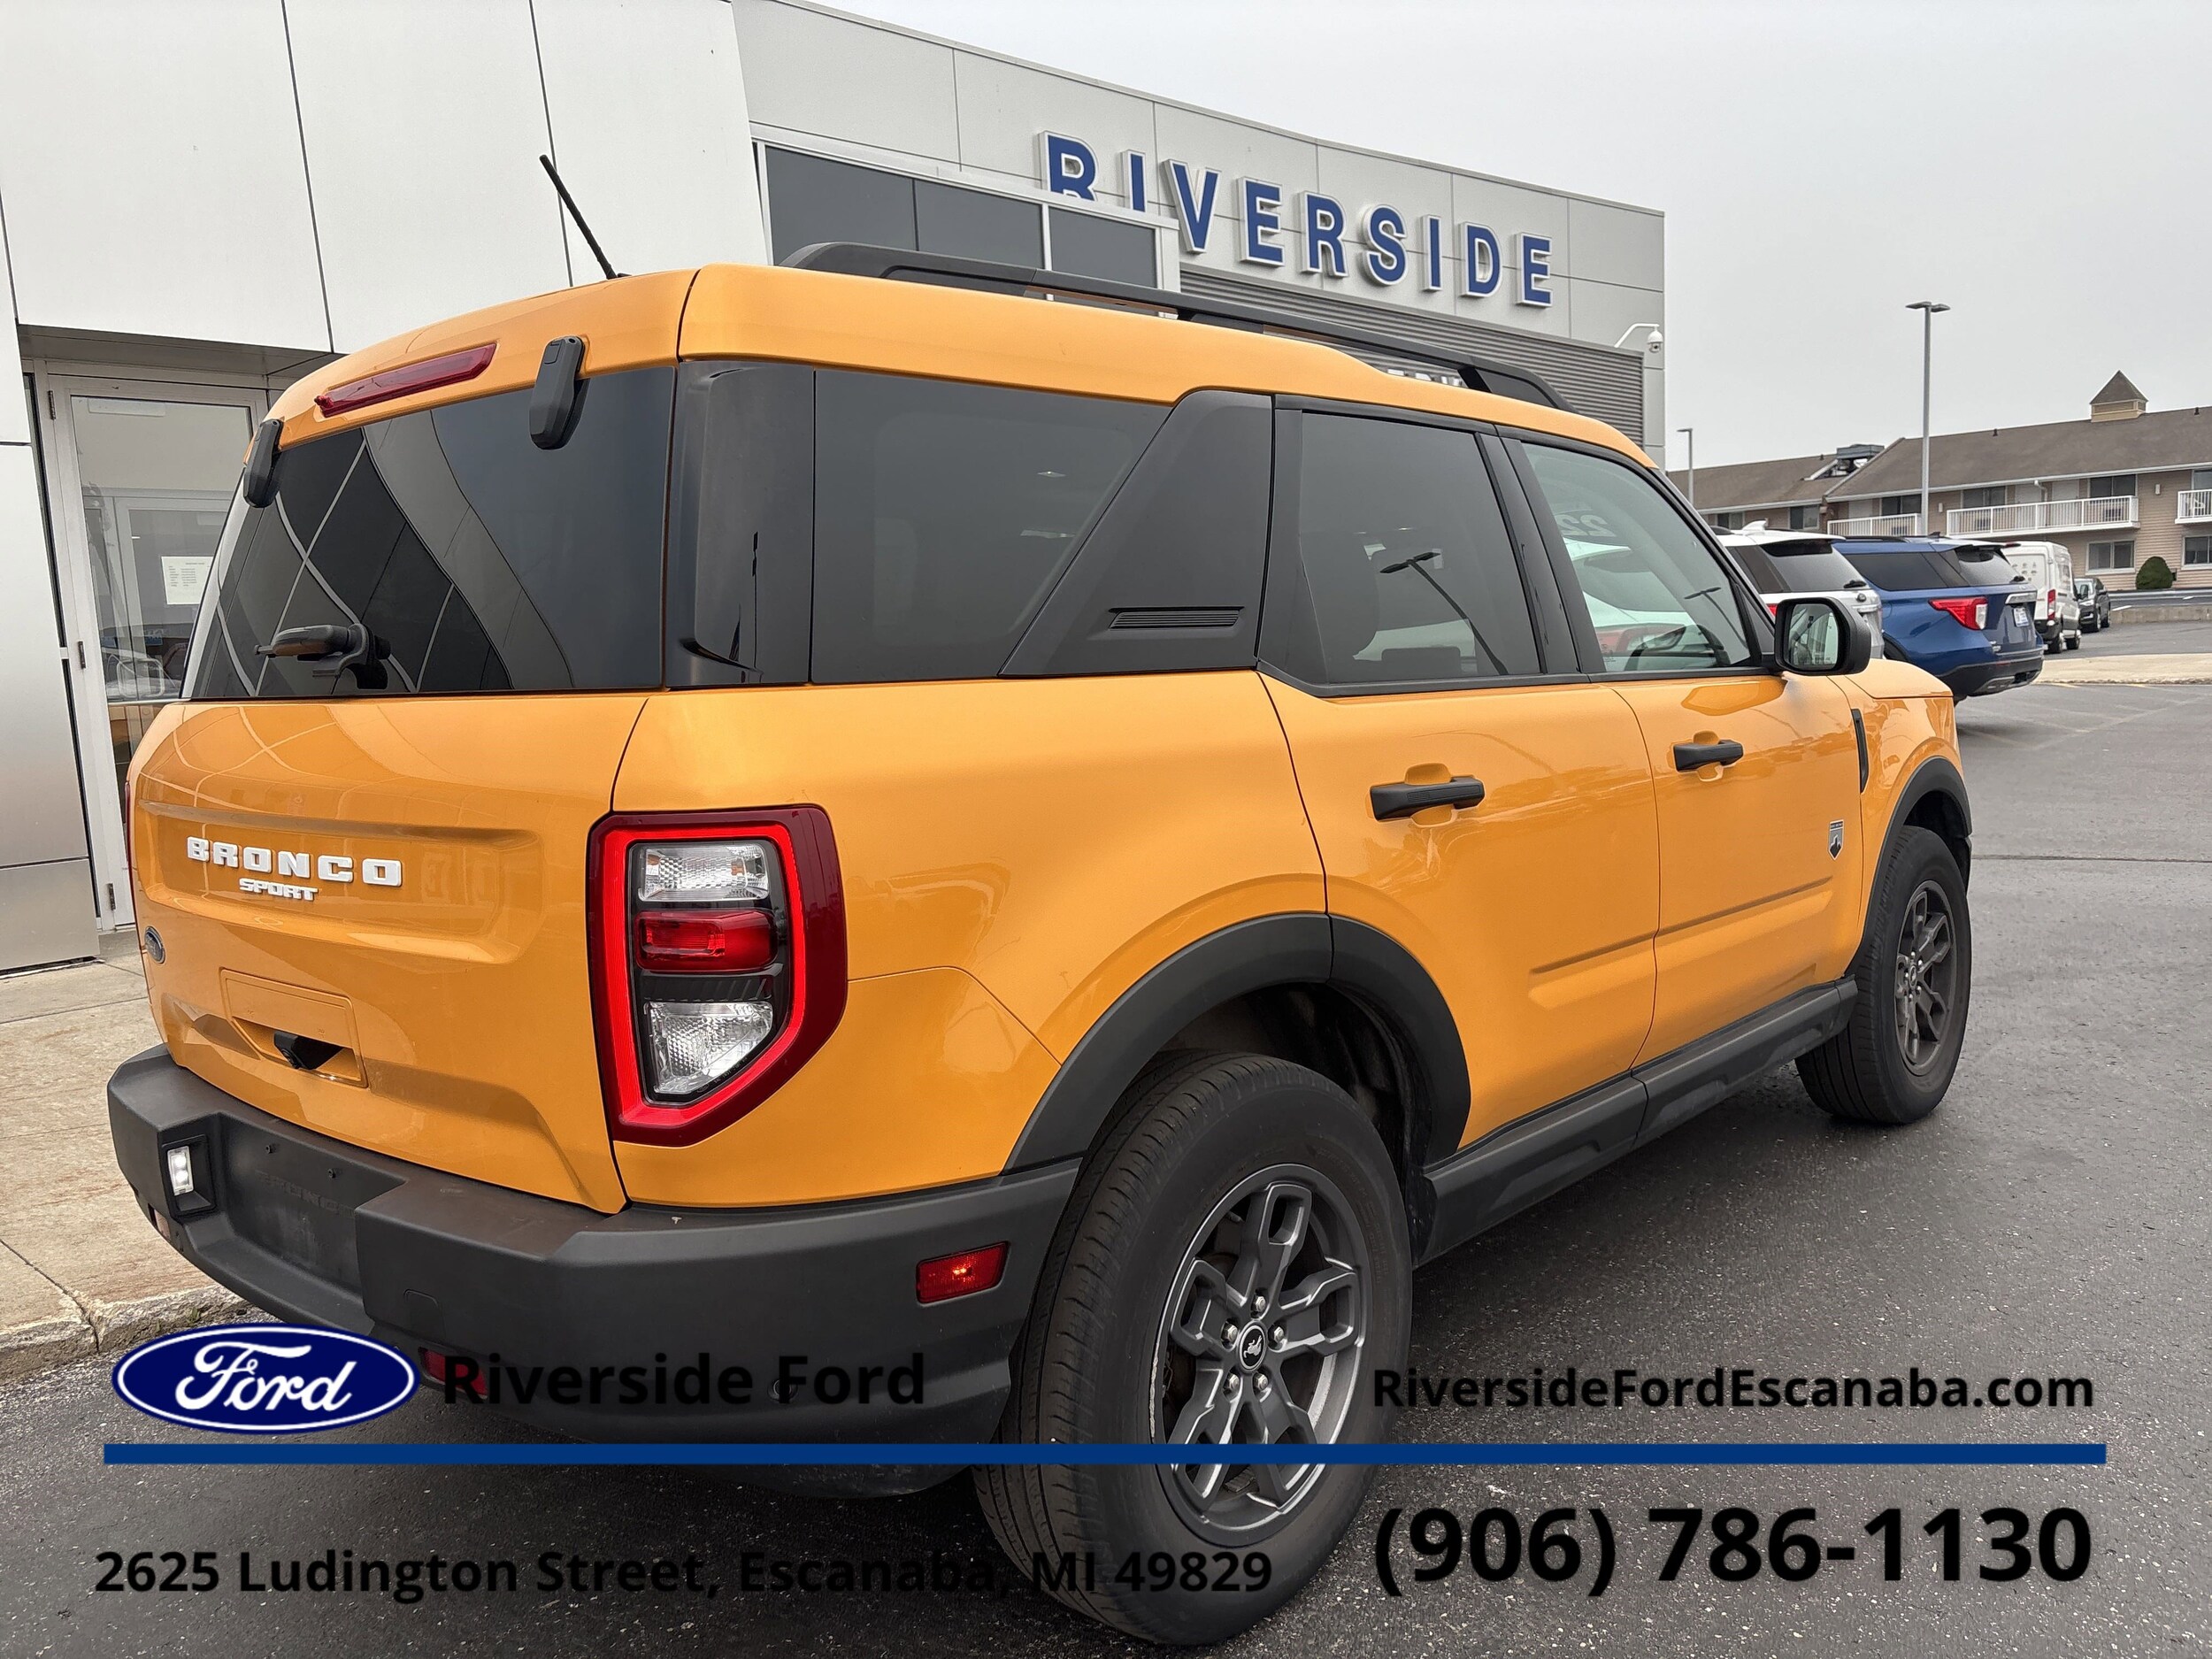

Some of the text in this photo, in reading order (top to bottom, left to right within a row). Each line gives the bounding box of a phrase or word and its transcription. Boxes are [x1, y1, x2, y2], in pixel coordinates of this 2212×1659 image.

[1041, 132, 1553, 306] RIVERSIDE
[187, 836, 402, 887] BRONCO
[239, 878, 319, 901] SPORT
